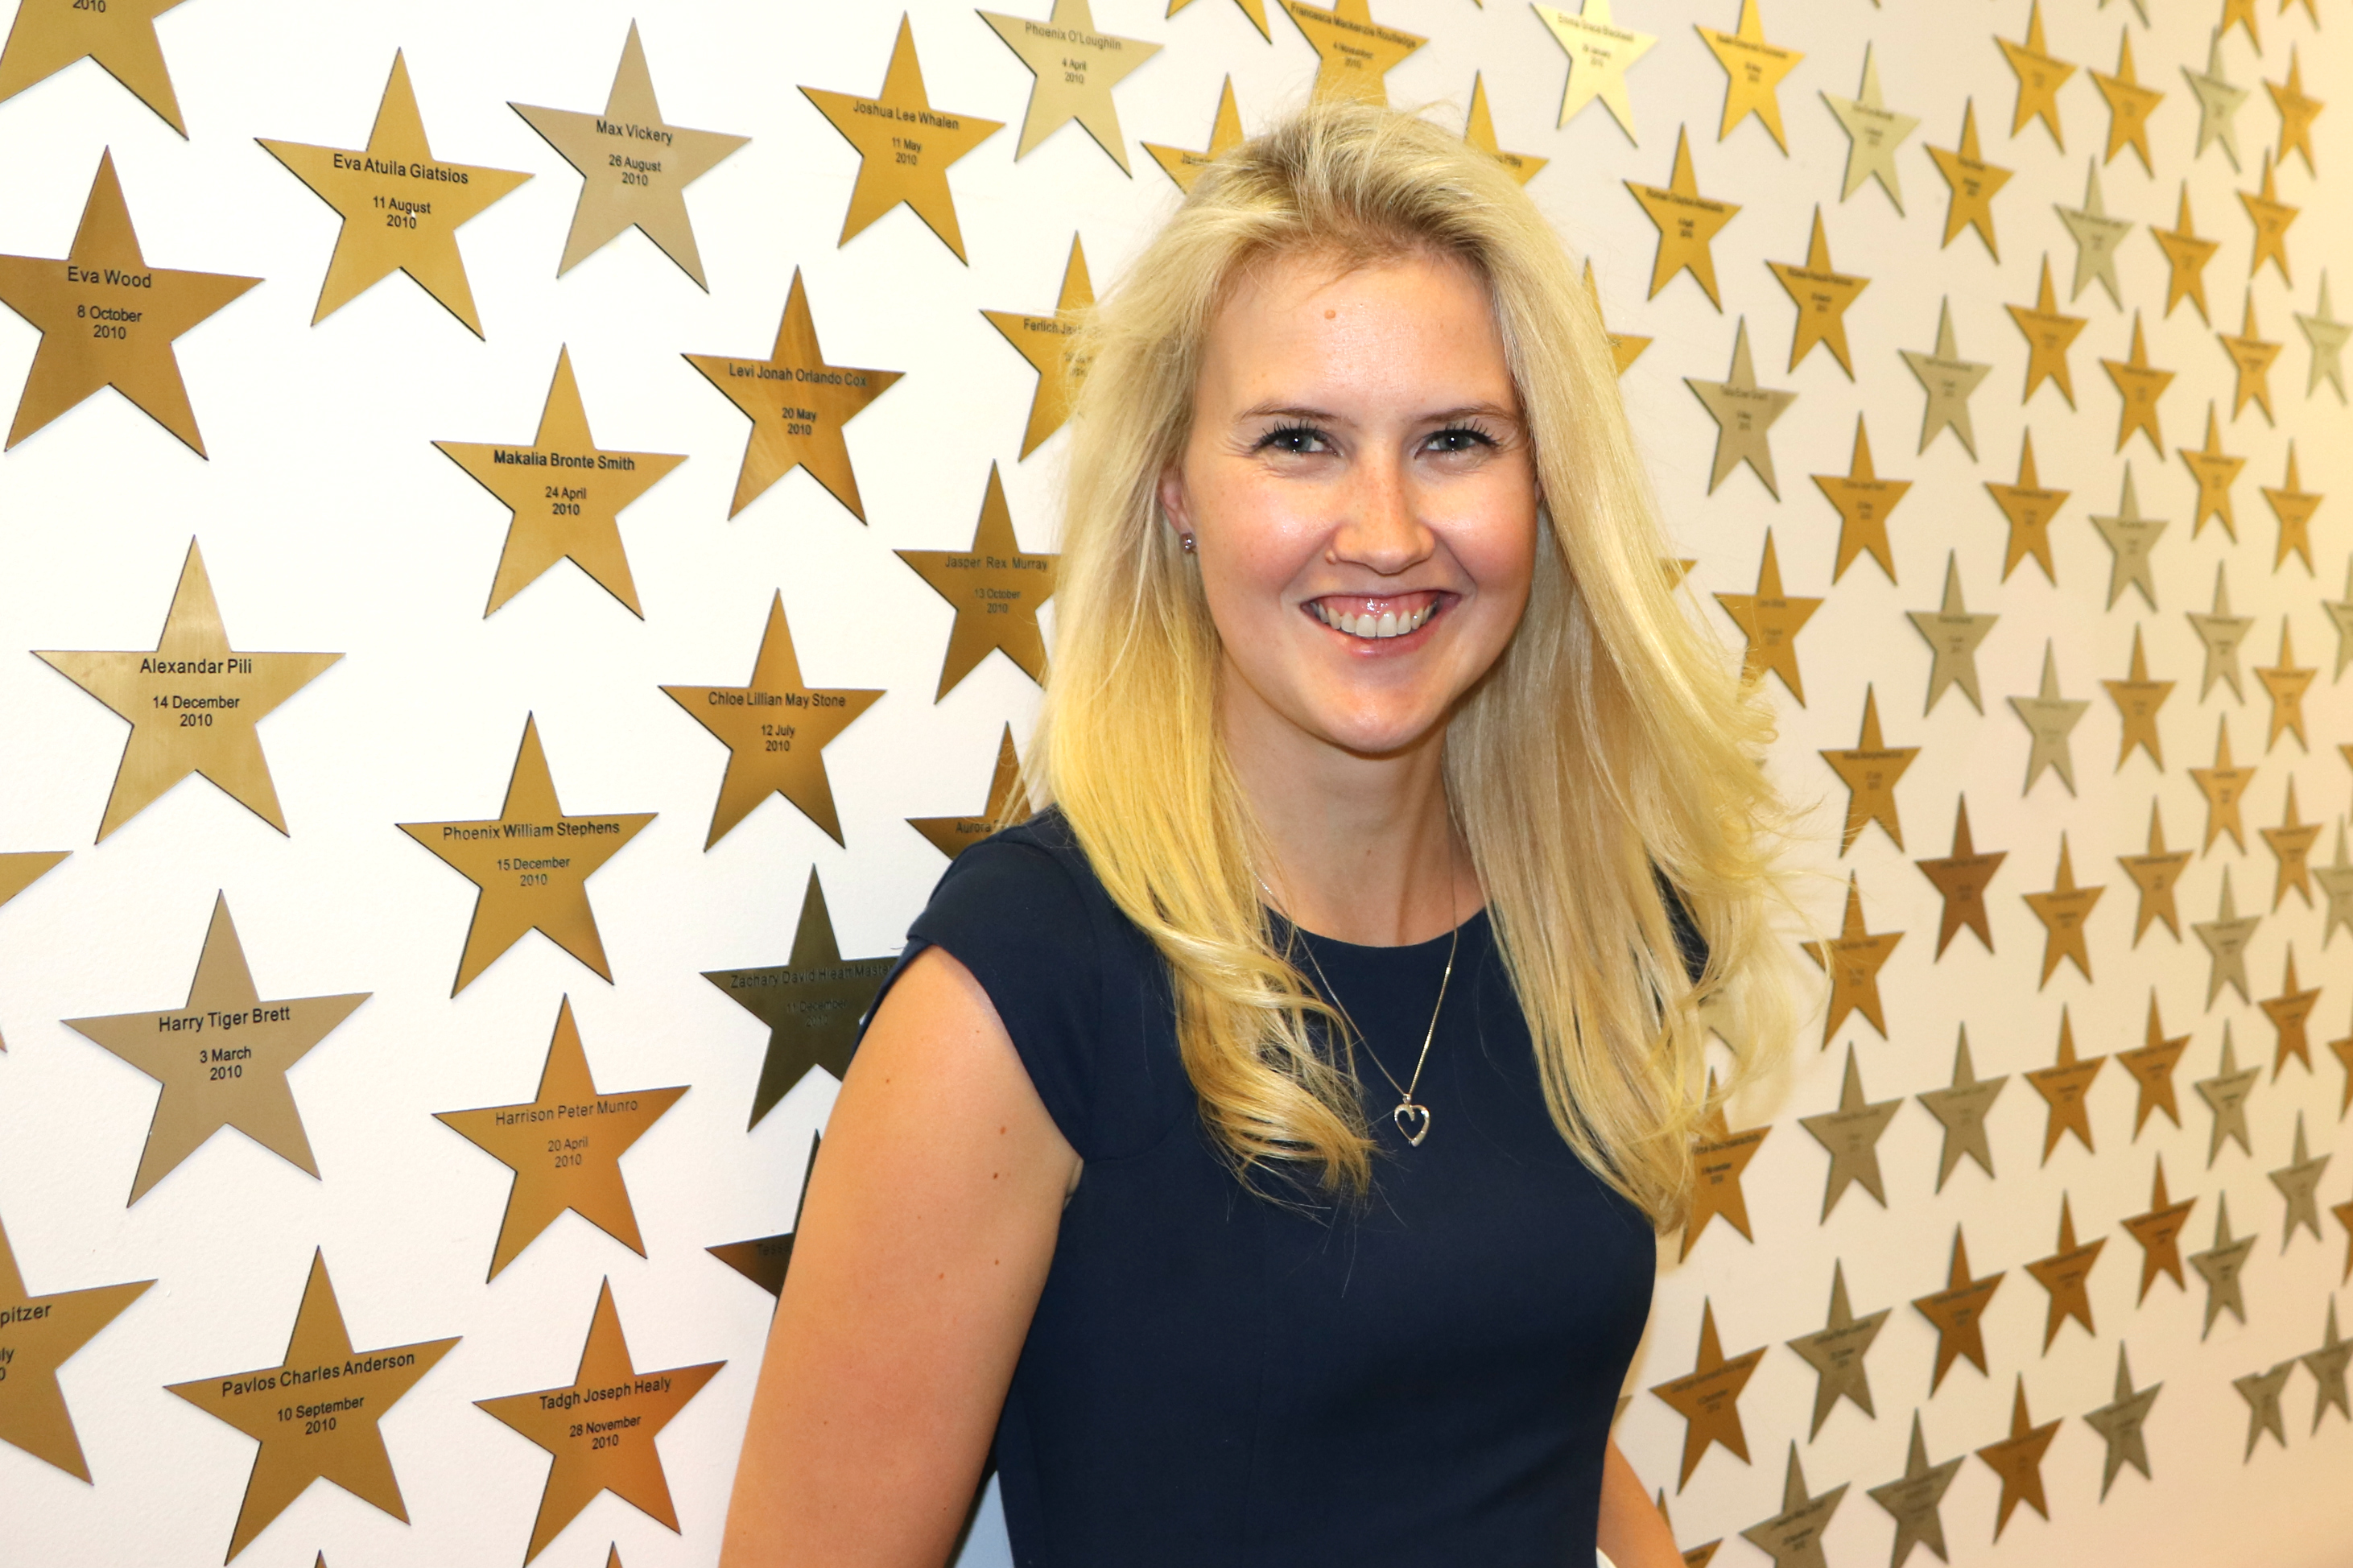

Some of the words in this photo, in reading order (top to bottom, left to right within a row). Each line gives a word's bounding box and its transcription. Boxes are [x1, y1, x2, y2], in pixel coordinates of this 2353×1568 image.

[1025, 23, 1067, 42] Phoenix
[1069, 29, 1121, 52] O'Loughlin
[1062, 58, 1069, 68] 4
[1071, 59, 1087, 73] April
[1064, 71, 1084, 84] 2010
[852, 101, 893, 120] Joshua
[896, 107, 914, 122] Lee
[918, 111, 959, 130] Whalen
[597, 121, 623, 138] Max
[626, 123, 673, 145] Vickery
[891, 138, 901, 150] 11
[903, 138, 922, 154] May
[609, 155, 622, 168] 26
[625, 156, 662, 173] August
[895, 152, 918, 166] 2010
[333, 153, 360, 171] Eva
[365, 158, 406, 178] Atuila
[410, 163, 469, 184] Giatsios
[622, 171, 648, 187] 2010
[373, 196, 386, 209] 11
[389, 198, 431, 217] August
[386, 214, 416, 229] 2010
[68, 266, 100, 284] Eva
[104, 270, 151, 288] Wood
[77, 305, 85, 318] 8
[89, 306, 142, 324] October
[93, 324, 126, 340] 2010
[1024, 319, 1059, 333] Ferlich
[729, 363, 754, 380] Levi
[757, 365, 793, 382] Jonah
[795, 368, 842, 386] Orlando
[844, 371, 868, 387] Cox
[782, 408, 795, 420] 20
[796, 408, 817, 423] May
[786, 423, 812, 436] 2010
[493, 450, 547, 467] Makalia
[551, 452, 595, 469] Bronte
[597, 454, 635, 471] Smith
[545, 486, 559, 499] 24
[561, 487, 587, 503] April
[551, 502, 580, 516] 2010
[945, 555, 981, 572] Jasper
[986, 556, 1007, 570] Rex
[1012, 557, 1048, 573] Murray
[974, 588, 985, 600] 13
[987, 588, 1021, 600] October
[987, 603, 1009, 614] 2010
[139, 658, 225, 675] Alexandar
[227, 658, 252, 675] Pili
[152, 695, 169, 709] 14
[172, 695, 241, 710] December
[708, 691, 744, 707] Chloe
[747, 692, 783, 707] Lillian
[785, 693, 810, 710] May
[811, 693, 846, 708] Stone
[180, 712, 213, 728] 2010
[761, 725, 772, 737] 12
[774, 725, 795, 740] July
[765, 740, 791, 752] 2010
[443, 825, 500, 842] Phoenix
[502, 823, 554, 839] William
[556, 820, 620, 840] Stephens
[955, 822, 992, 833] Aurora
[497, 858, 510, 872] 15
[513, 855, 570, 871] December
[519, 872, 548, 886] 2010
[730, 972, 778, 988] Zachary
[782, 969, 815, 984] David
[786, 1003, 796, 1013] 11
[799, 1000, 846, 1013] December
[159, 1013, 204, 1034] Harry
[208, 1010, 249, 1031] Tiger
[252, 1005, 291, 1025] Brett
[806, 1015, 829, 1027] 2010
[200, 1050, 208, 1064] 3
[211, 1046, 251, 1063] March
[209, 1064, 243, 1082] 2010
[495, 1106, 555, 1126] Harrison
[558, 1102, 593, 1120] Peter
[597, 1098, 638, 1116] Munro
[547, 1139, 561, 1153] 20
[564, 1136, 589, 1153] April
[555, 1153, 582, 1167] 2010
[221, 1373, 276, 1398] Pavlos
[279, 1365, 341, 1389] Charles
[344, 1351, 415, 1376] Anderson
[539, 1392, 580, 1412] Tadgh
[583, 1383, 631, 1407] Joseph
[634, 1376, 671, 1398] Healy
[276, 1408, 292, 1422] 10
[295, 1395, 365, 1422] September
[304, 1417, 336, 1436] 2010
[569, 1424, 583, 1437] 28
[585, 1414, 642, 1435] November
[592, 1434, 619, 1450] 2010
